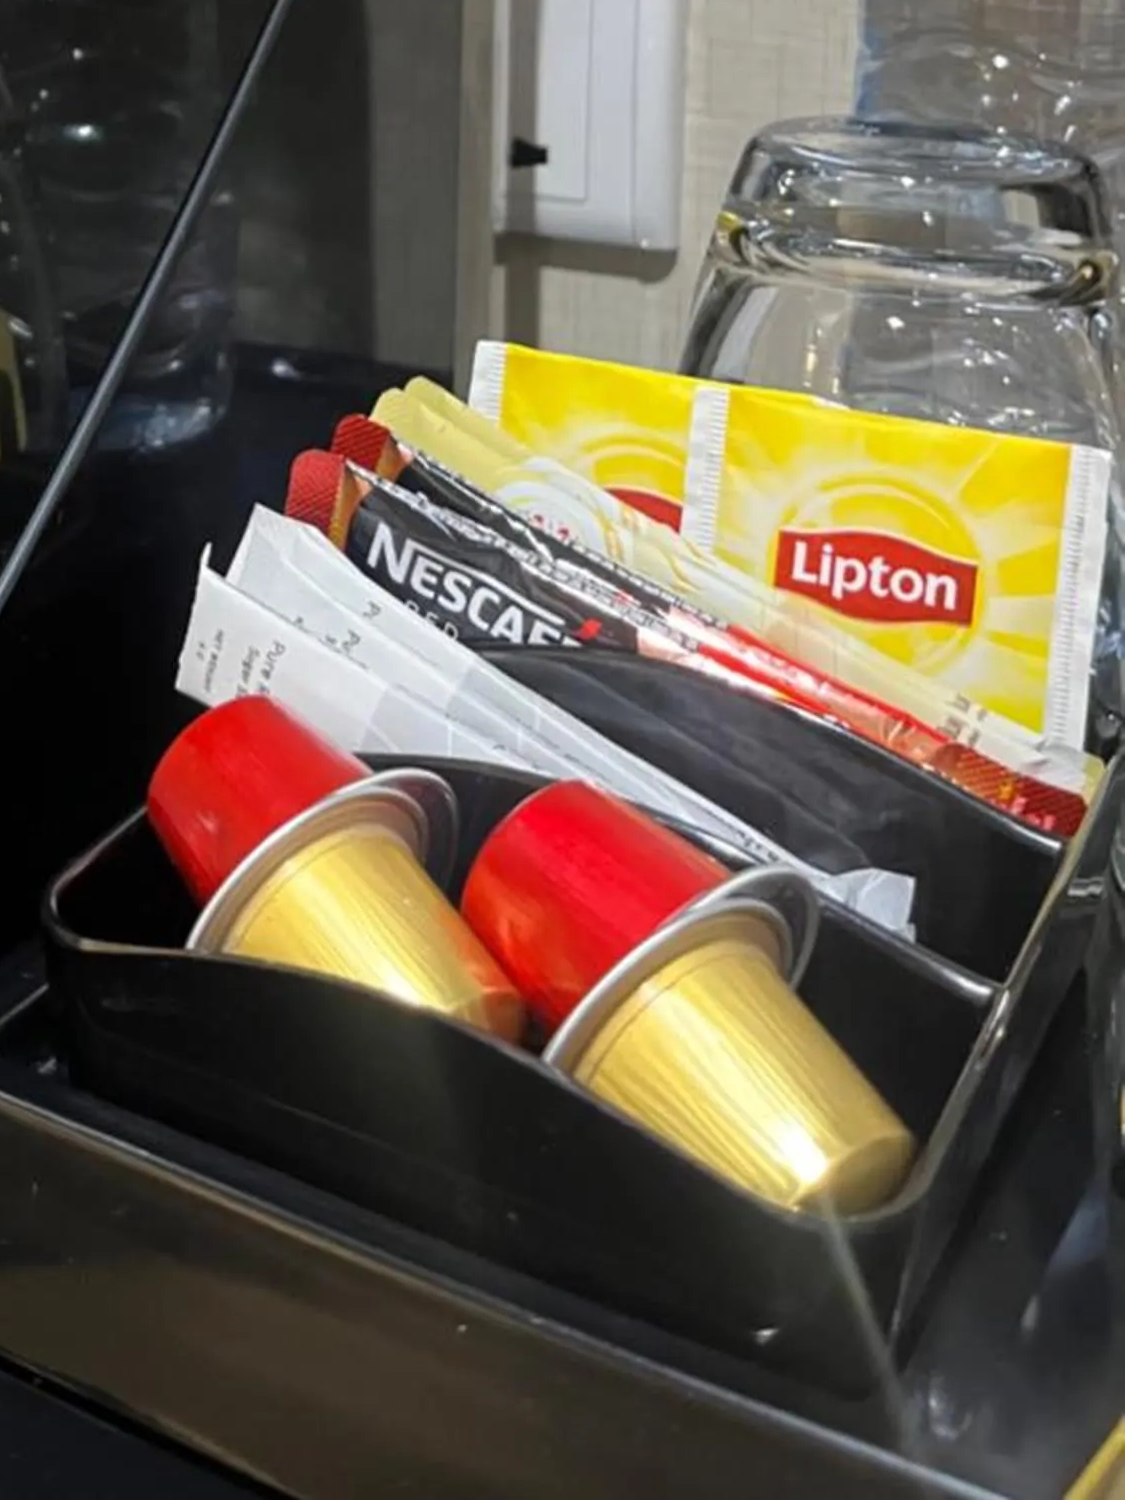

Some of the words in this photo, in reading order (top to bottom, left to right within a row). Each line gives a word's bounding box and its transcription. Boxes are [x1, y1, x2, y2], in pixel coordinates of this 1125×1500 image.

[367, 520, 583, 647] NESCAF
[791, 540, 957, 611] Lipton
[260, 640, 286, 680] Pure
